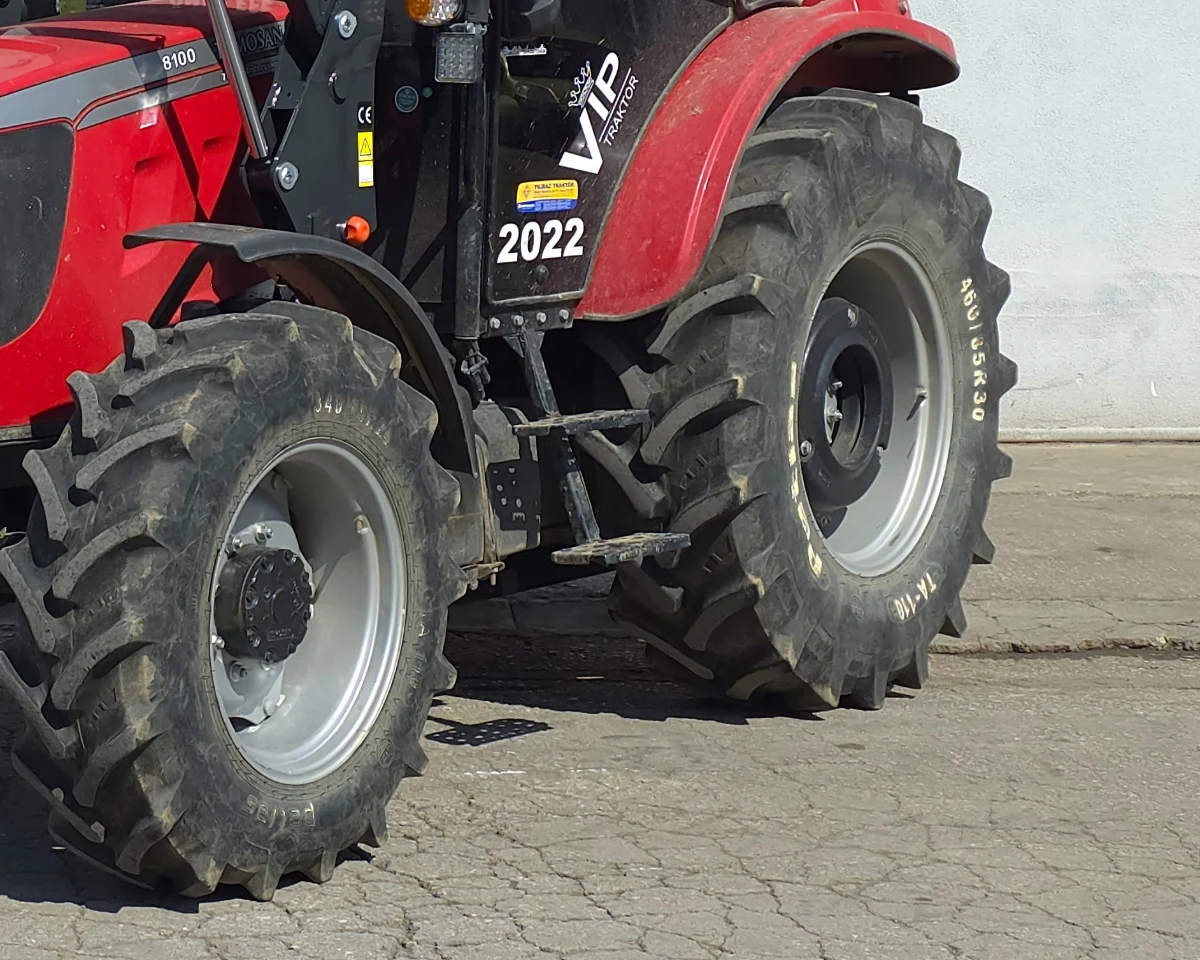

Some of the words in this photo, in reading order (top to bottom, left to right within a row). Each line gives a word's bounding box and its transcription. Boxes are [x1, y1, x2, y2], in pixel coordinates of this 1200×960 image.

[240, 24, 285, 53] MOSAN
[162, 47, 197, 71] 8100
[358, 106, 373, 124] CE
[558, 51, 619, 174] VIP
[603, 74, 640, 147] TRAKTOR
[496, 216, 585, 264] 2022
